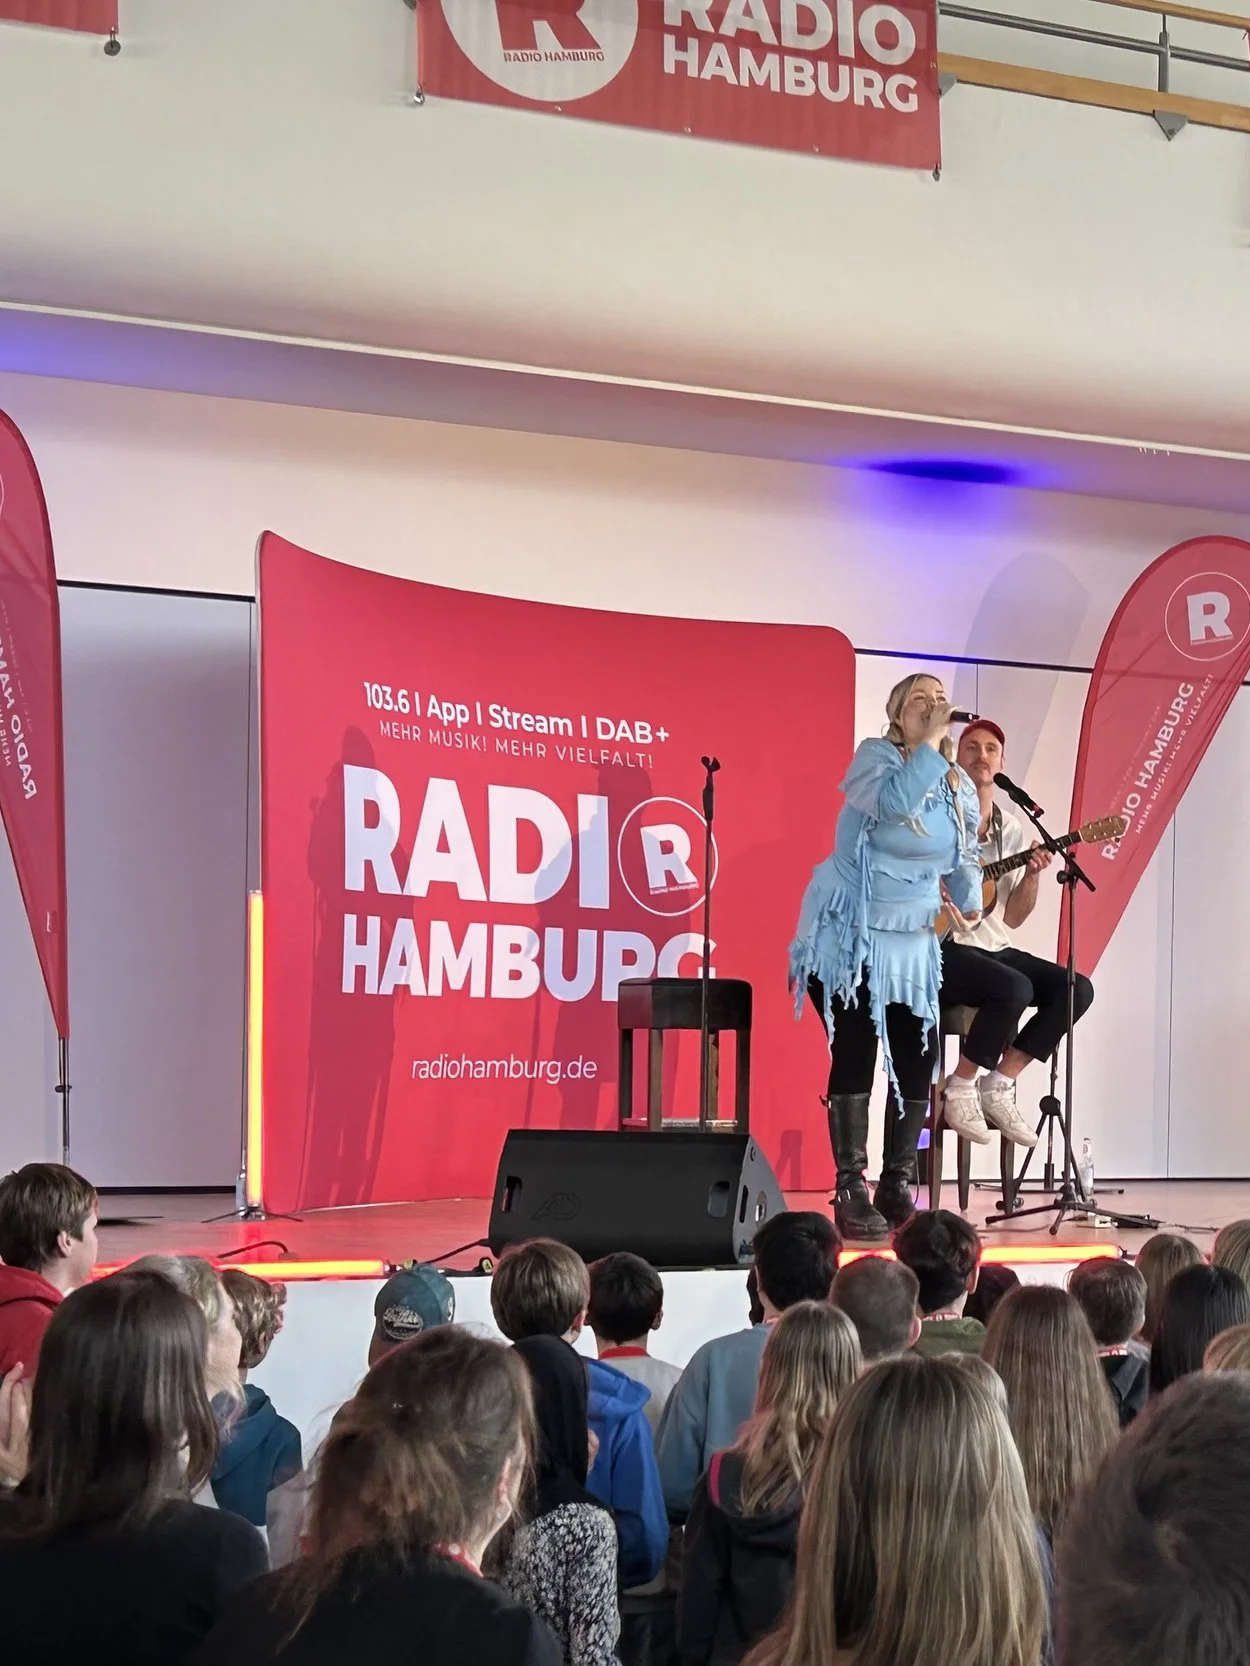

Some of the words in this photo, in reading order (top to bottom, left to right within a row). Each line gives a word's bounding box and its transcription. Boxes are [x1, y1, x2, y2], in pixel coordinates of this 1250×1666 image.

[504, 52, 541, 62] RADIO
[545, 51, 604, 62] HAMBURG
[664, 34, 918, 112] HAMBURG
[1186, 591, 1233, 641] R
[364, 681, 409, 714] 103.6
[427, 694, 470, 728] App
[488, 702, 574, 737] Stream
[596, 716, 671, 744] DAB+
[1134, 682, 1194, 789] HAMBURG
[379, 719, 423, 743] MEHR
[428, 727, 488, 752] MUSIK!
[495, 737, 548, 758] MEHR
[556, 745, 655, 769] VIELFALT!
[411, 1054, 598, 1085] radiohamburg.de
